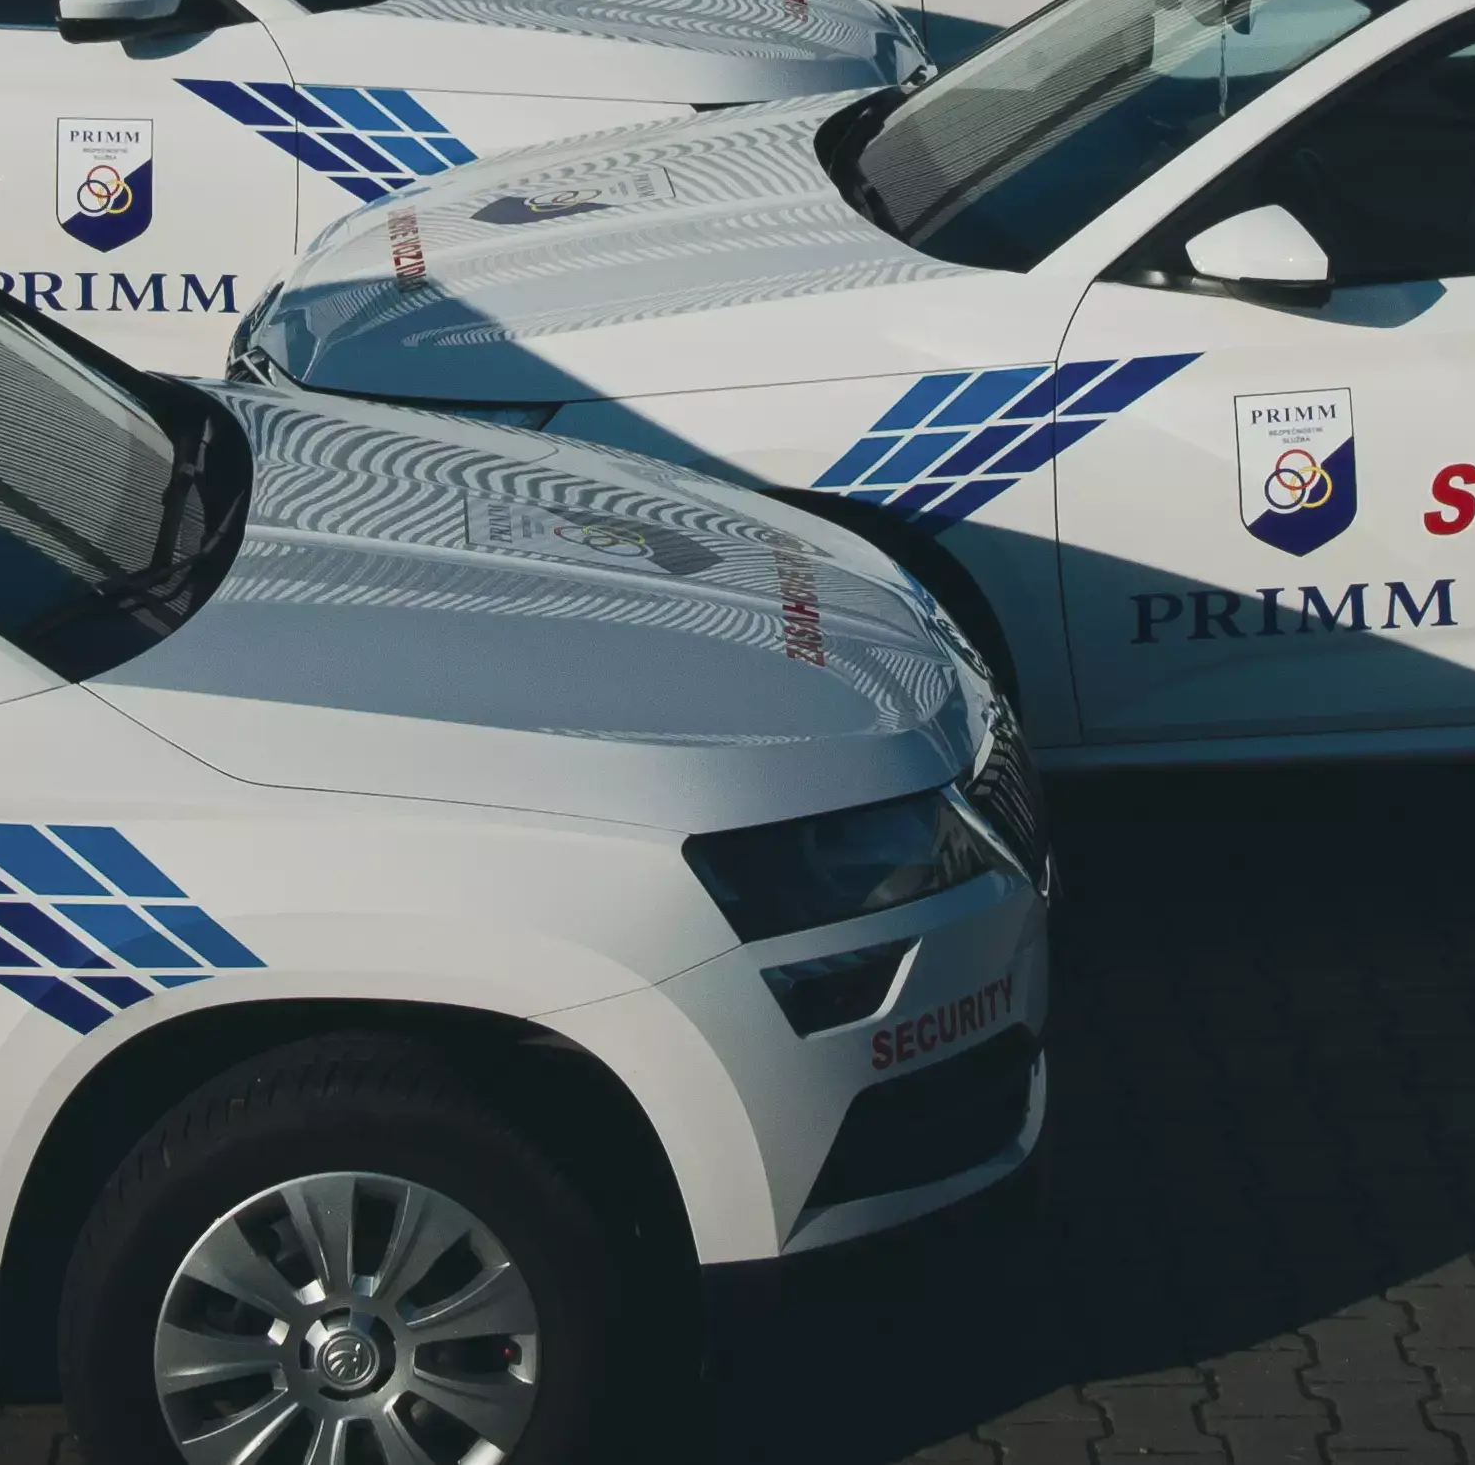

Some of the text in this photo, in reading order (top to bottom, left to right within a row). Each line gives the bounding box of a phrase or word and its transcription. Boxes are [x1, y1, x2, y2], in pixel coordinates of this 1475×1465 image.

[69, 130, 140, 143] PRIMM
[1250, 403, 1337, 425] PRIMM
[1130, 578, 1459, 644] PRIMM
[871, 972, 1013, 1070] SECURITY
